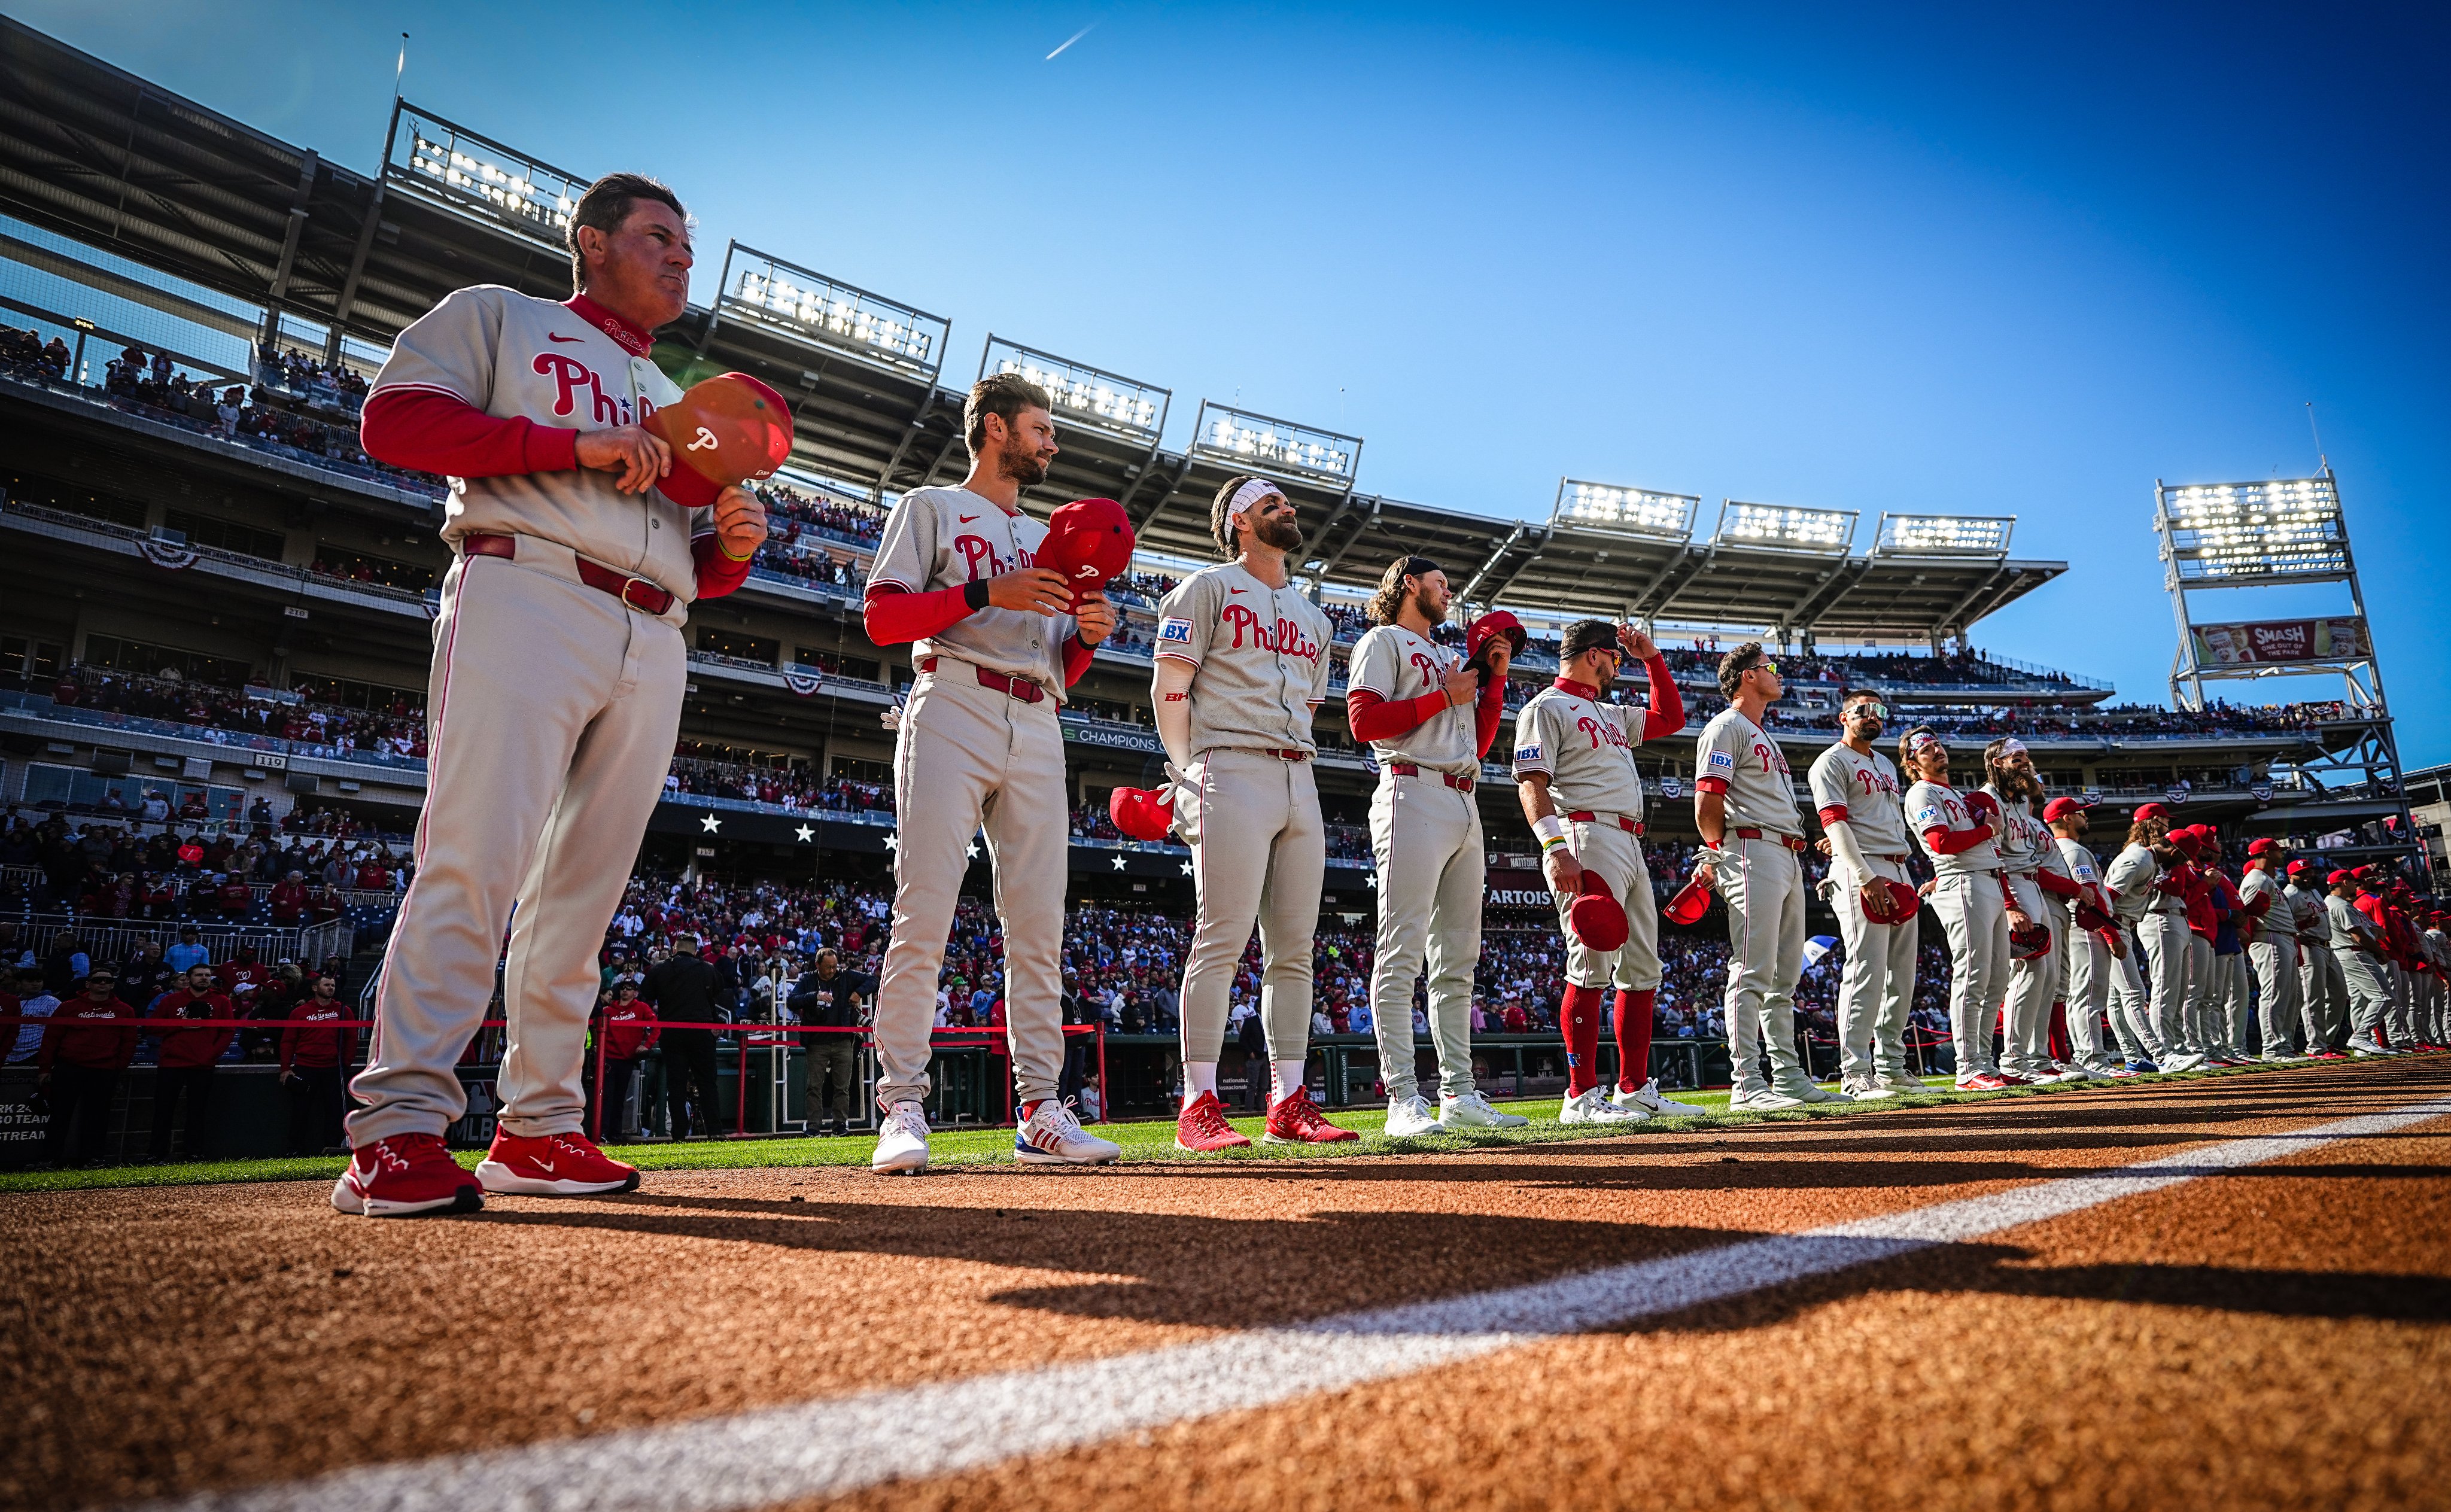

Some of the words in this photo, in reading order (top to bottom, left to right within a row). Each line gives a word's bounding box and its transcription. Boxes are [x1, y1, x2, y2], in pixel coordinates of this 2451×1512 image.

[687, 427, 718, 451] P
[1075, 565, 1099, 579] P
[2254, 625, 2306, 646] SMASH
[2261, 643, 2276, 652] ONE
[1079, 729, 1155, 751] CHAMPIONS
[1516, 747, 1540, 760] IBX
[259, 756, 282, 767] 119
[1711, 755, 1732, 768] IBX
[1510, 856, 1538, 868] NATITUDE
[2076, 866, 2092, 875] IBX
[1489, 889, 1551, 905] ARTOIS
[78, 1010, 115, 1018] Nationals
[306, 1010, 339, 1021] Nationals
[450, 1117, 494, 1141] MLB
